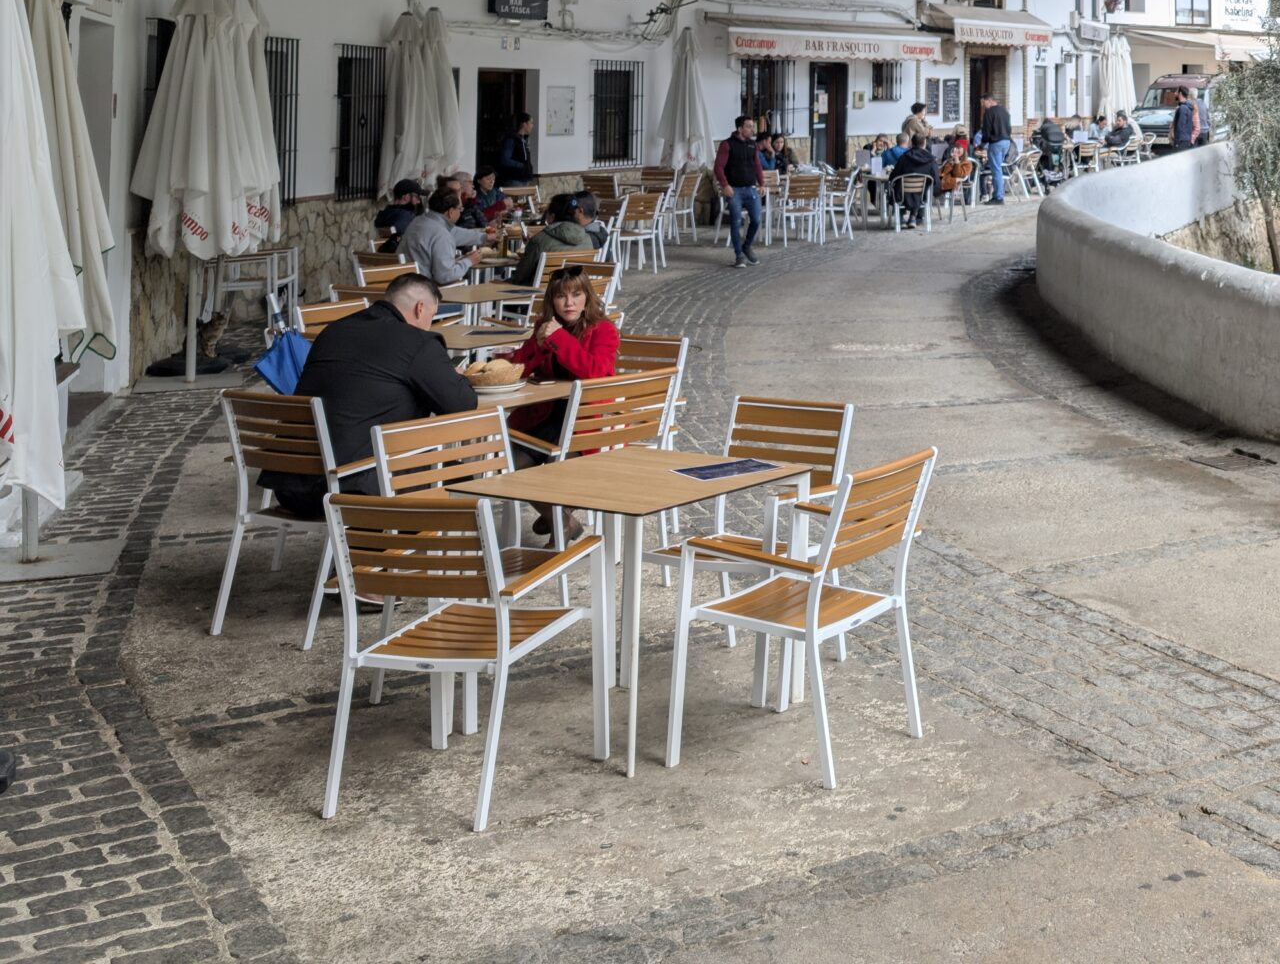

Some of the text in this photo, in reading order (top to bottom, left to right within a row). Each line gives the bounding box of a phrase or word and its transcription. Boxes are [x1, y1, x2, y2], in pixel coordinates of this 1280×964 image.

[500, 5, 531, 15] LA TASCA
[960, 27, 1013, 41] BAR FRASQUITO
[735, 36, 777, 50] Cruzcampo
[805, 39, 880, 55] BAR FRASQUITO
[902, 44, 935, 56] Cruzcampo
